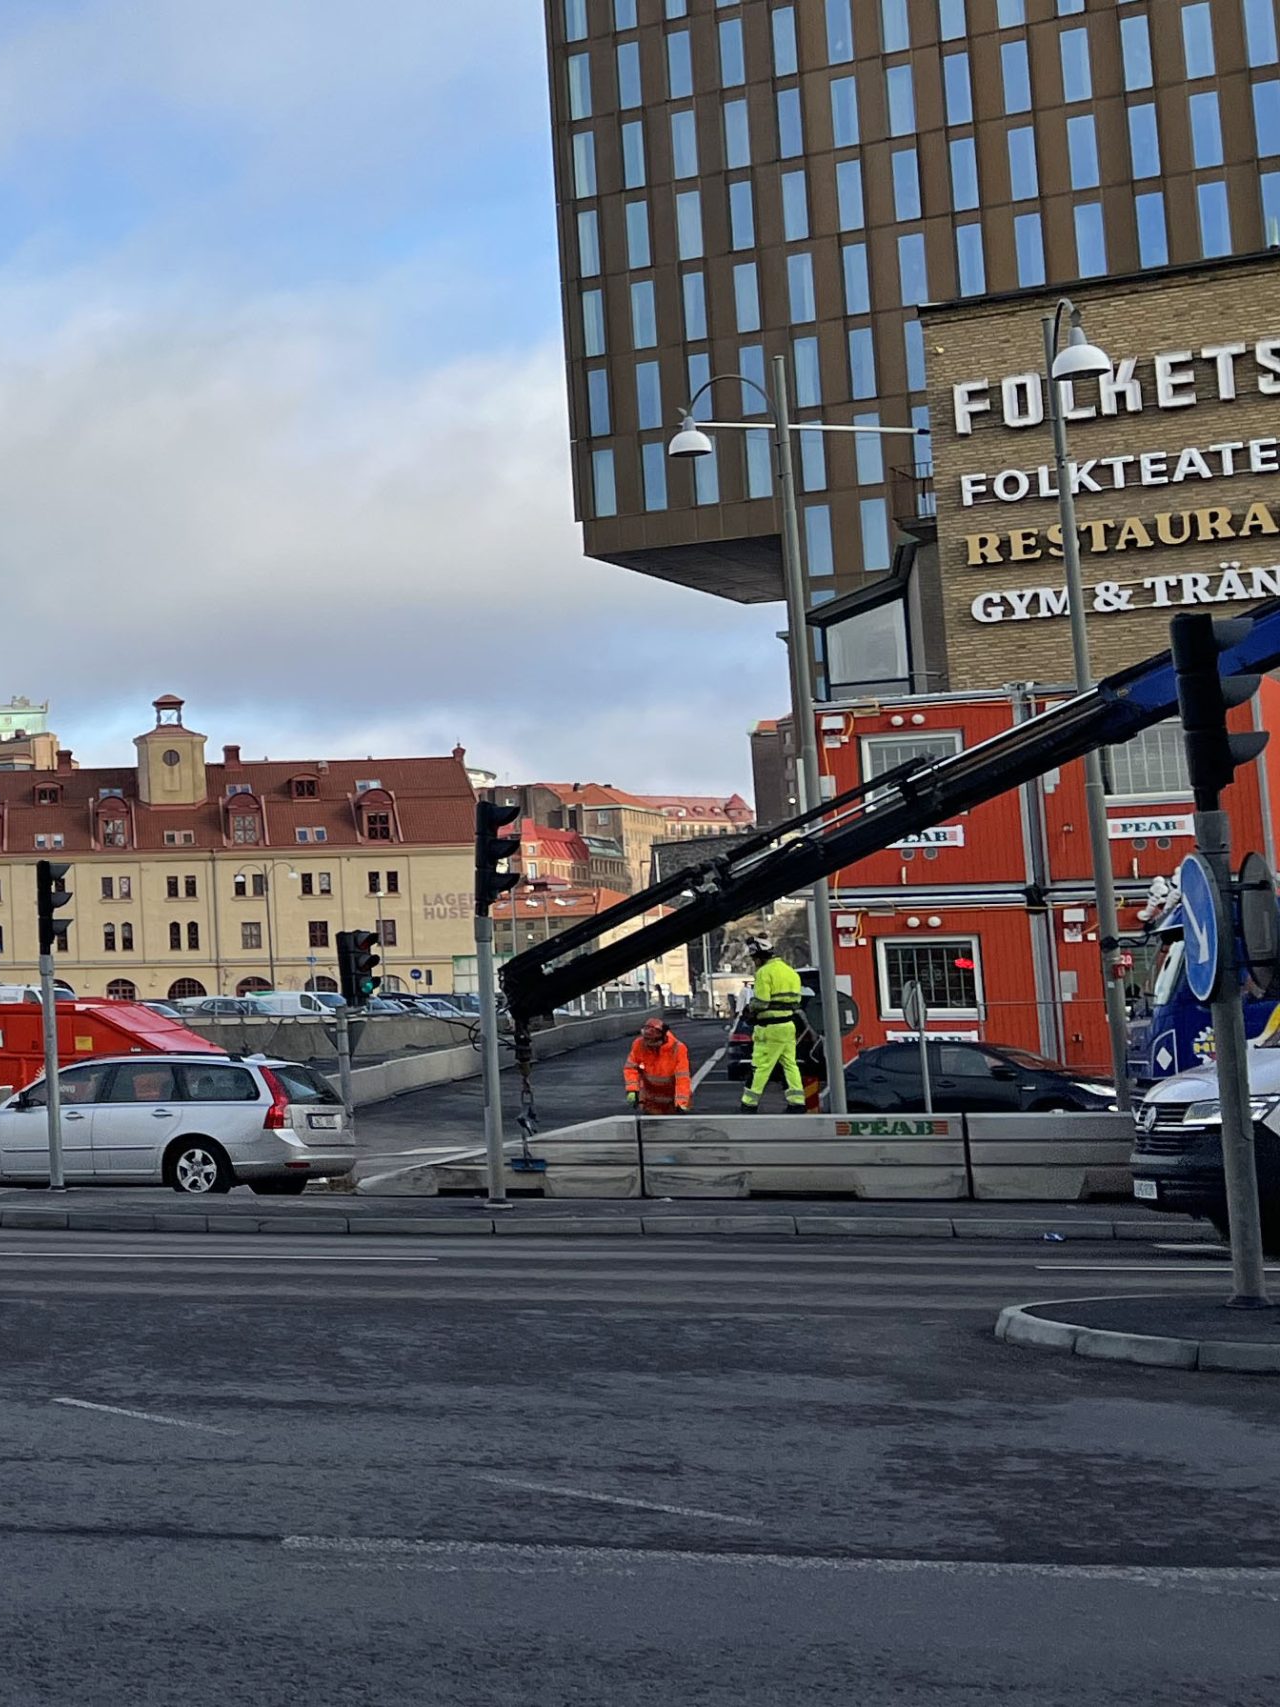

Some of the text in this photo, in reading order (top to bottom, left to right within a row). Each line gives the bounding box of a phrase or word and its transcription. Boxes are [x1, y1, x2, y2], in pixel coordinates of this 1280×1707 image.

[953, 338, 1280, 434] FOLKETS
[961, 438, 1280, 506] FOLKTEATE
[965, 502, 1280, 565] RESTAURA
[971, 561, 1280, 623] GYM & TRÄN
[1120, 820, 1178, 833] PEAB
[423, 906, 474, 920] HUSE
[849, 1119, 934, 1136] PEAB
